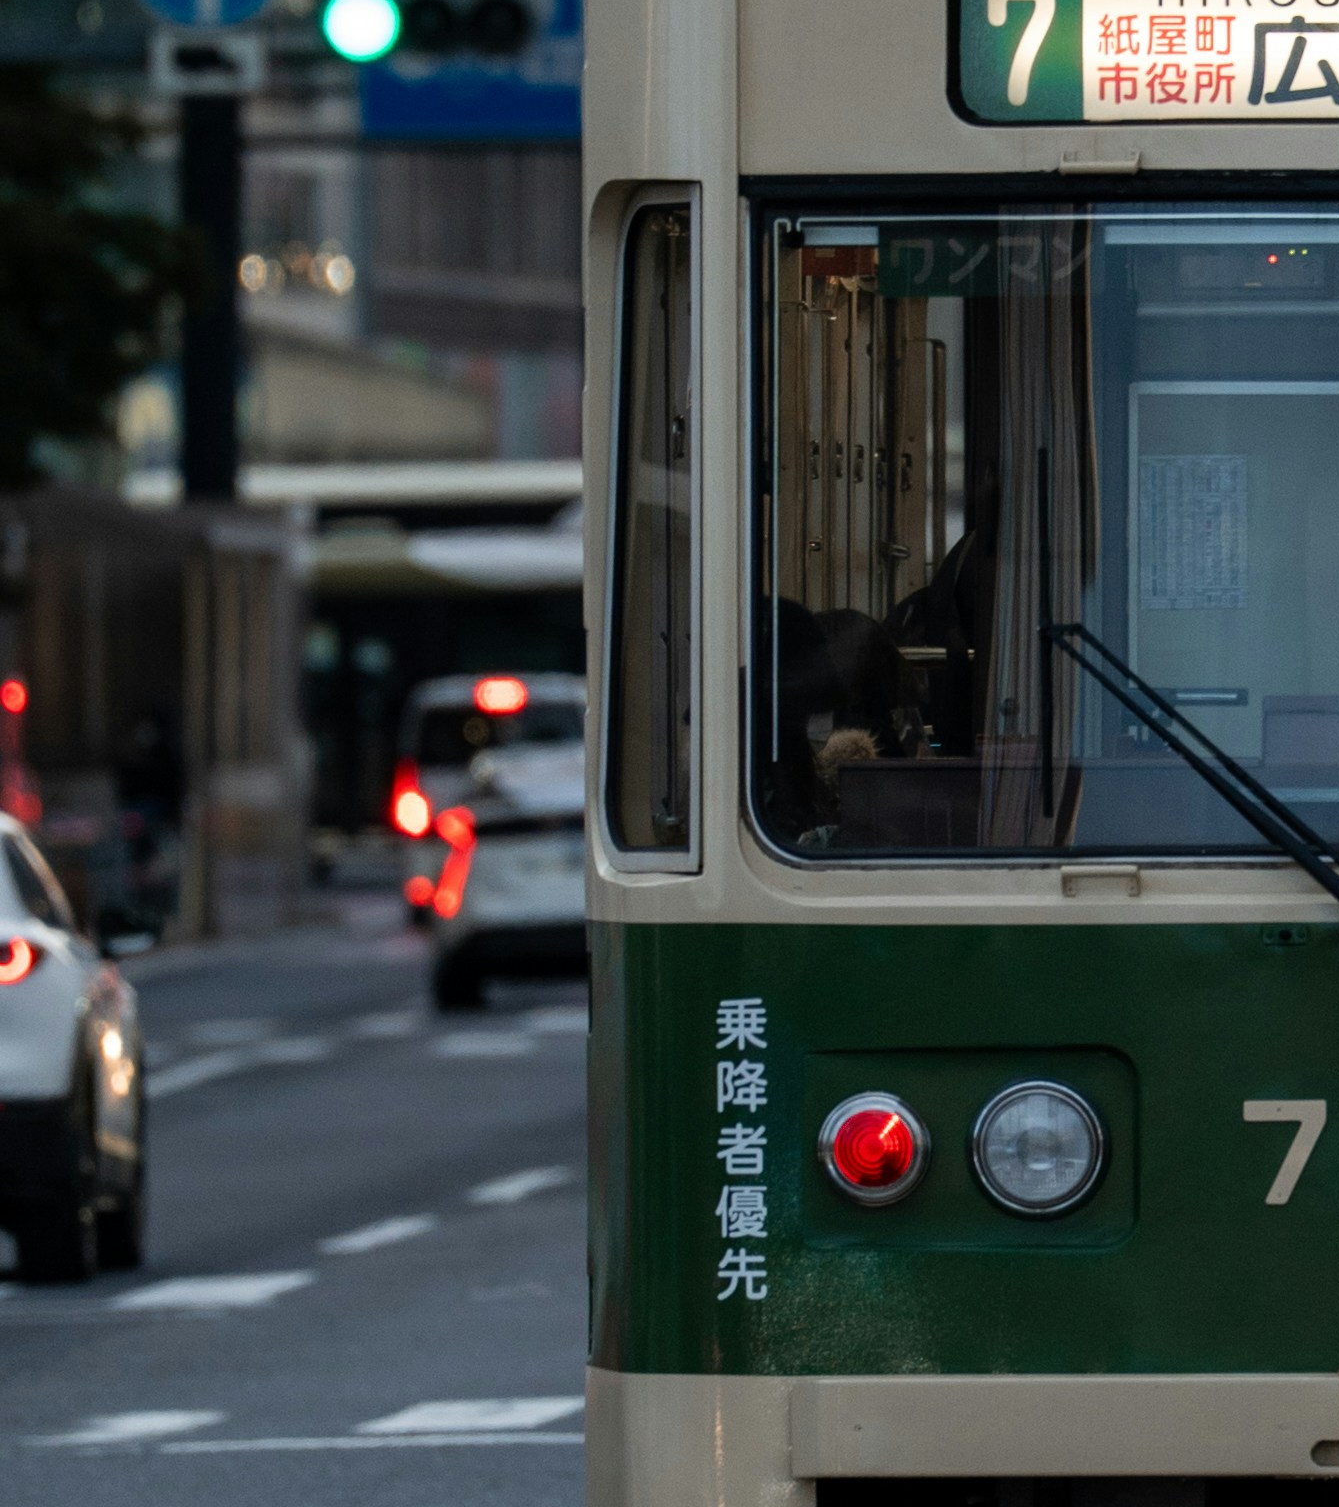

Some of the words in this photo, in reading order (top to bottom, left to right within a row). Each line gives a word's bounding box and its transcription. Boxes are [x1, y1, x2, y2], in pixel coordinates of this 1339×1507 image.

[1098, 14, 1236, 56] 紙屋町
[1098, 62, 1236, 105] 市役所
[890, 238, 1094, 284] ワンマン
[716, 998, 768, 1301] 乗降者優先
